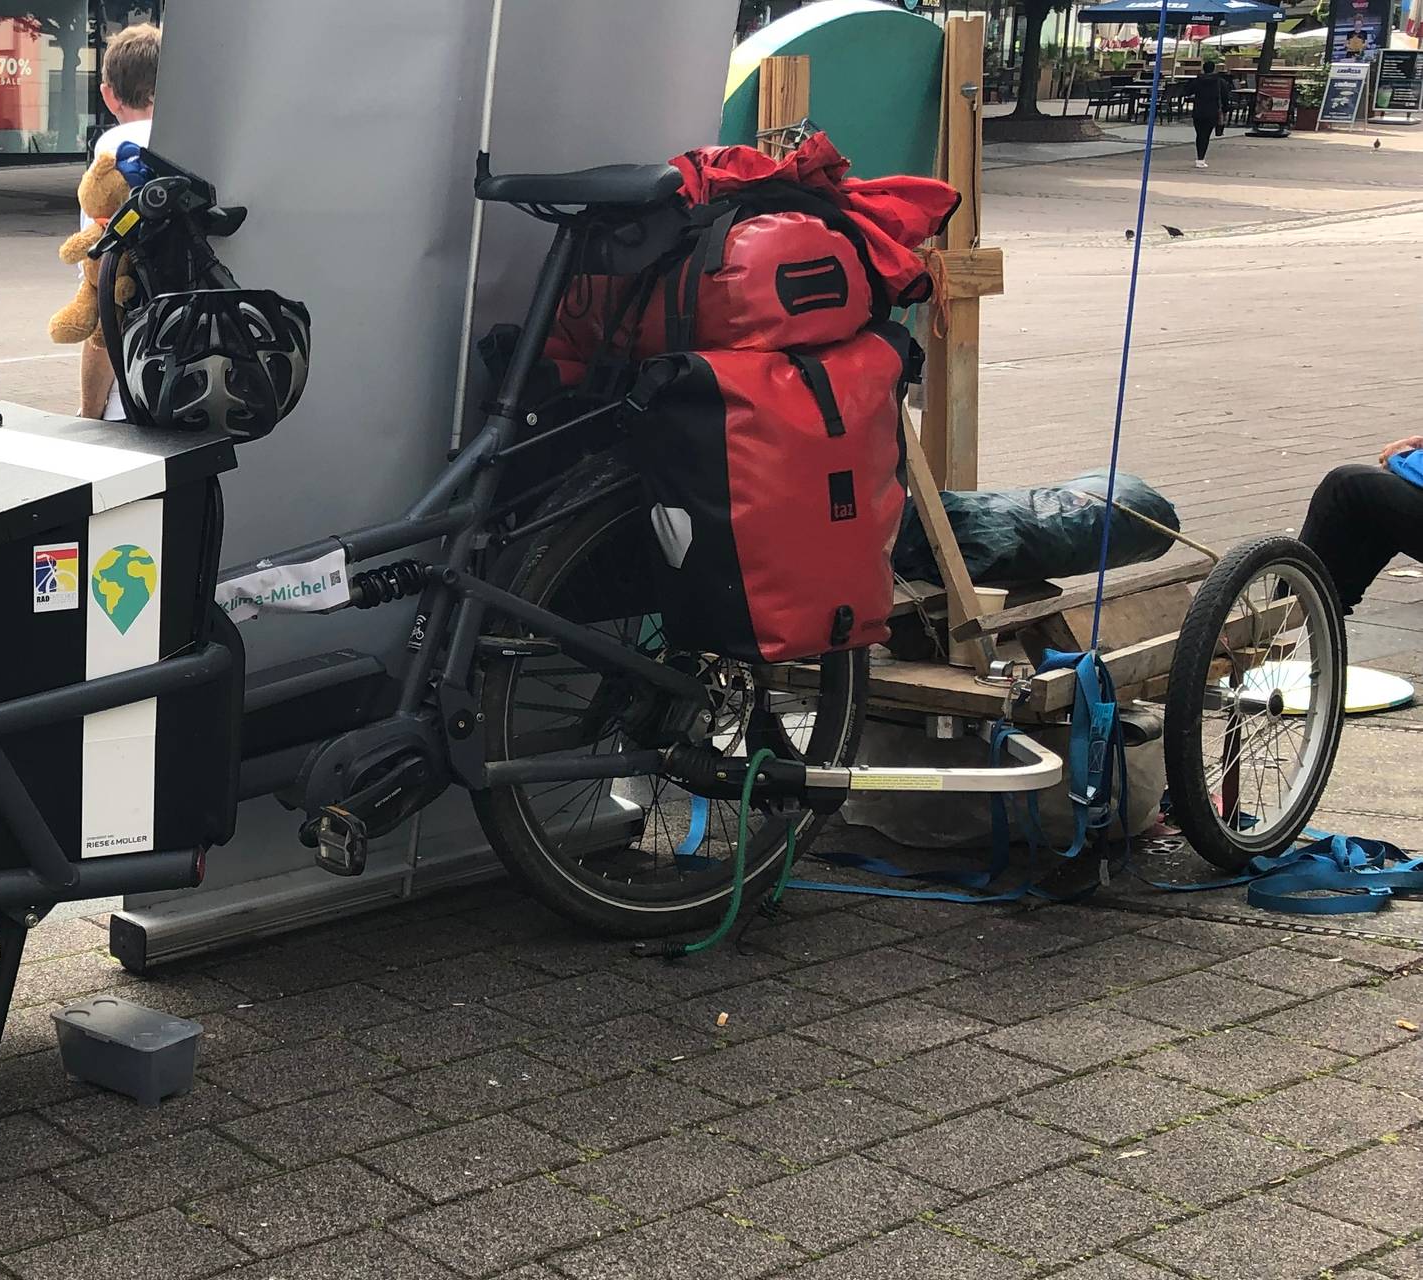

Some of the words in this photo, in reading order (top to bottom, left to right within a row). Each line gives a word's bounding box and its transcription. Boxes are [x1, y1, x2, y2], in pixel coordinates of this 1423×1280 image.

[0, 76, 23, 86] SALE
[833, 503, 854, 519] taz
[36, 595, 50, 604] RAD
[86, 840, 110, 849] RIESE
